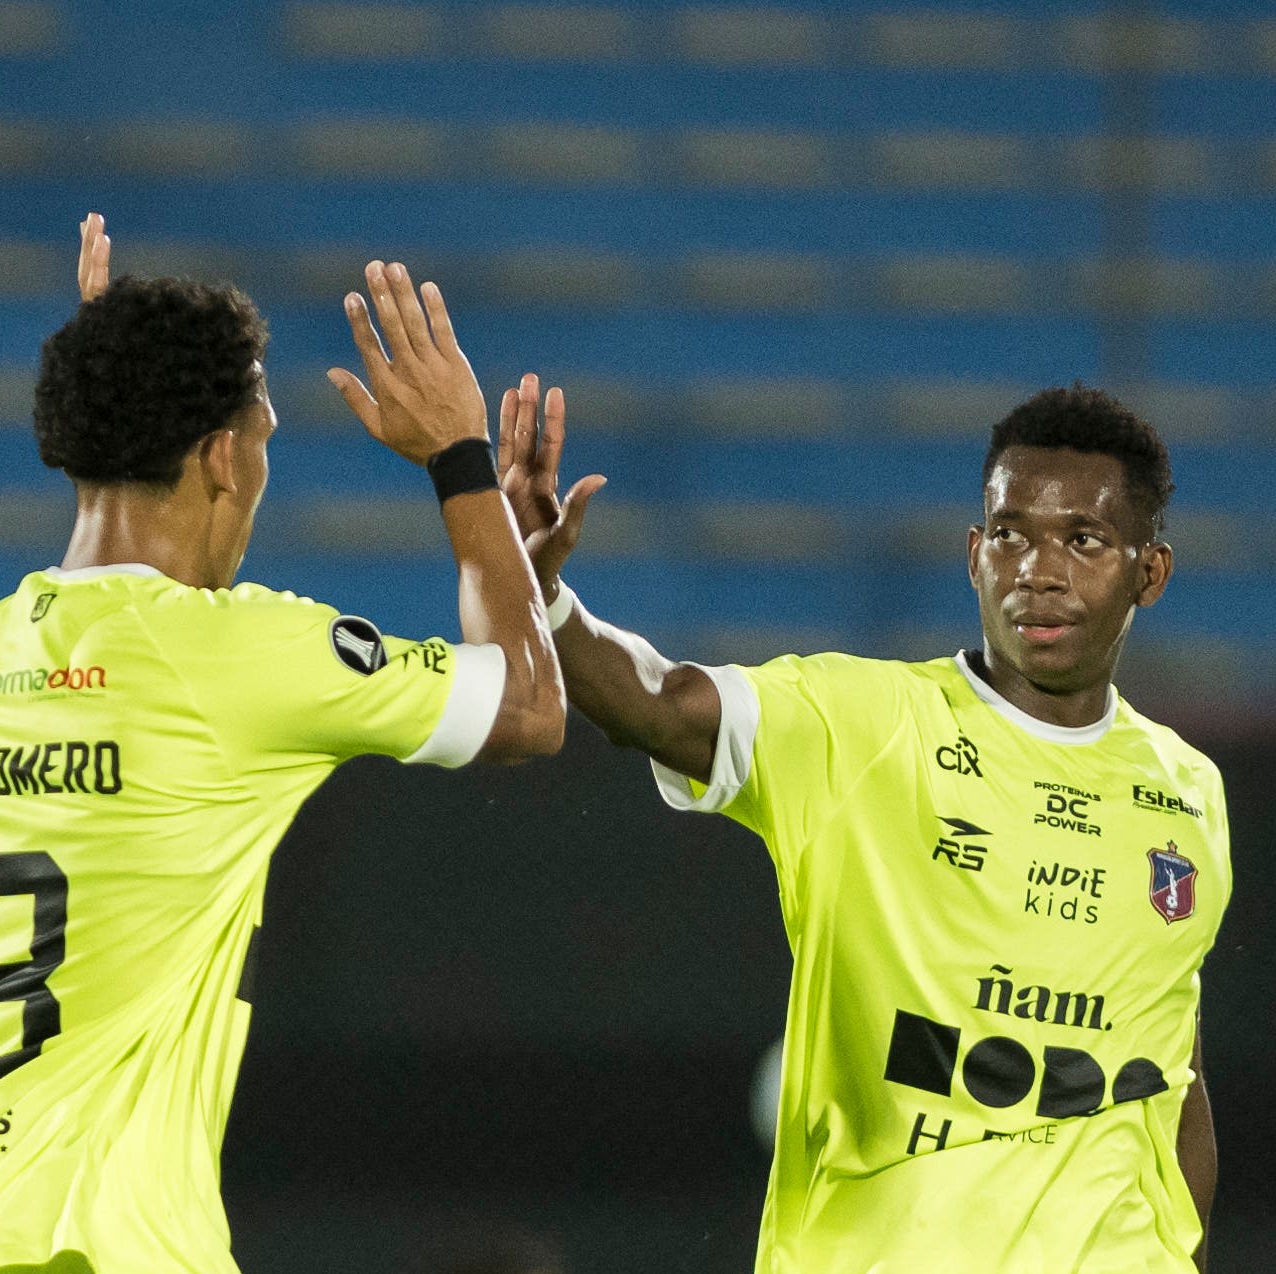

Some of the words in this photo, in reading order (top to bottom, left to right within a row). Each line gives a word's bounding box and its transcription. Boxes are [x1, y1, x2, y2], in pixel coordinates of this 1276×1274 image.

[1033, 781, 1102, 802] PROTEINAS
[1046, 793, 1089, 819] DC
[1033, 813, 1102, 838] POWER
[932, 837, 989, 873] RS
[1024, 888, 1099, 925] kids
[972, 963, 1113, 1032] ñam.
